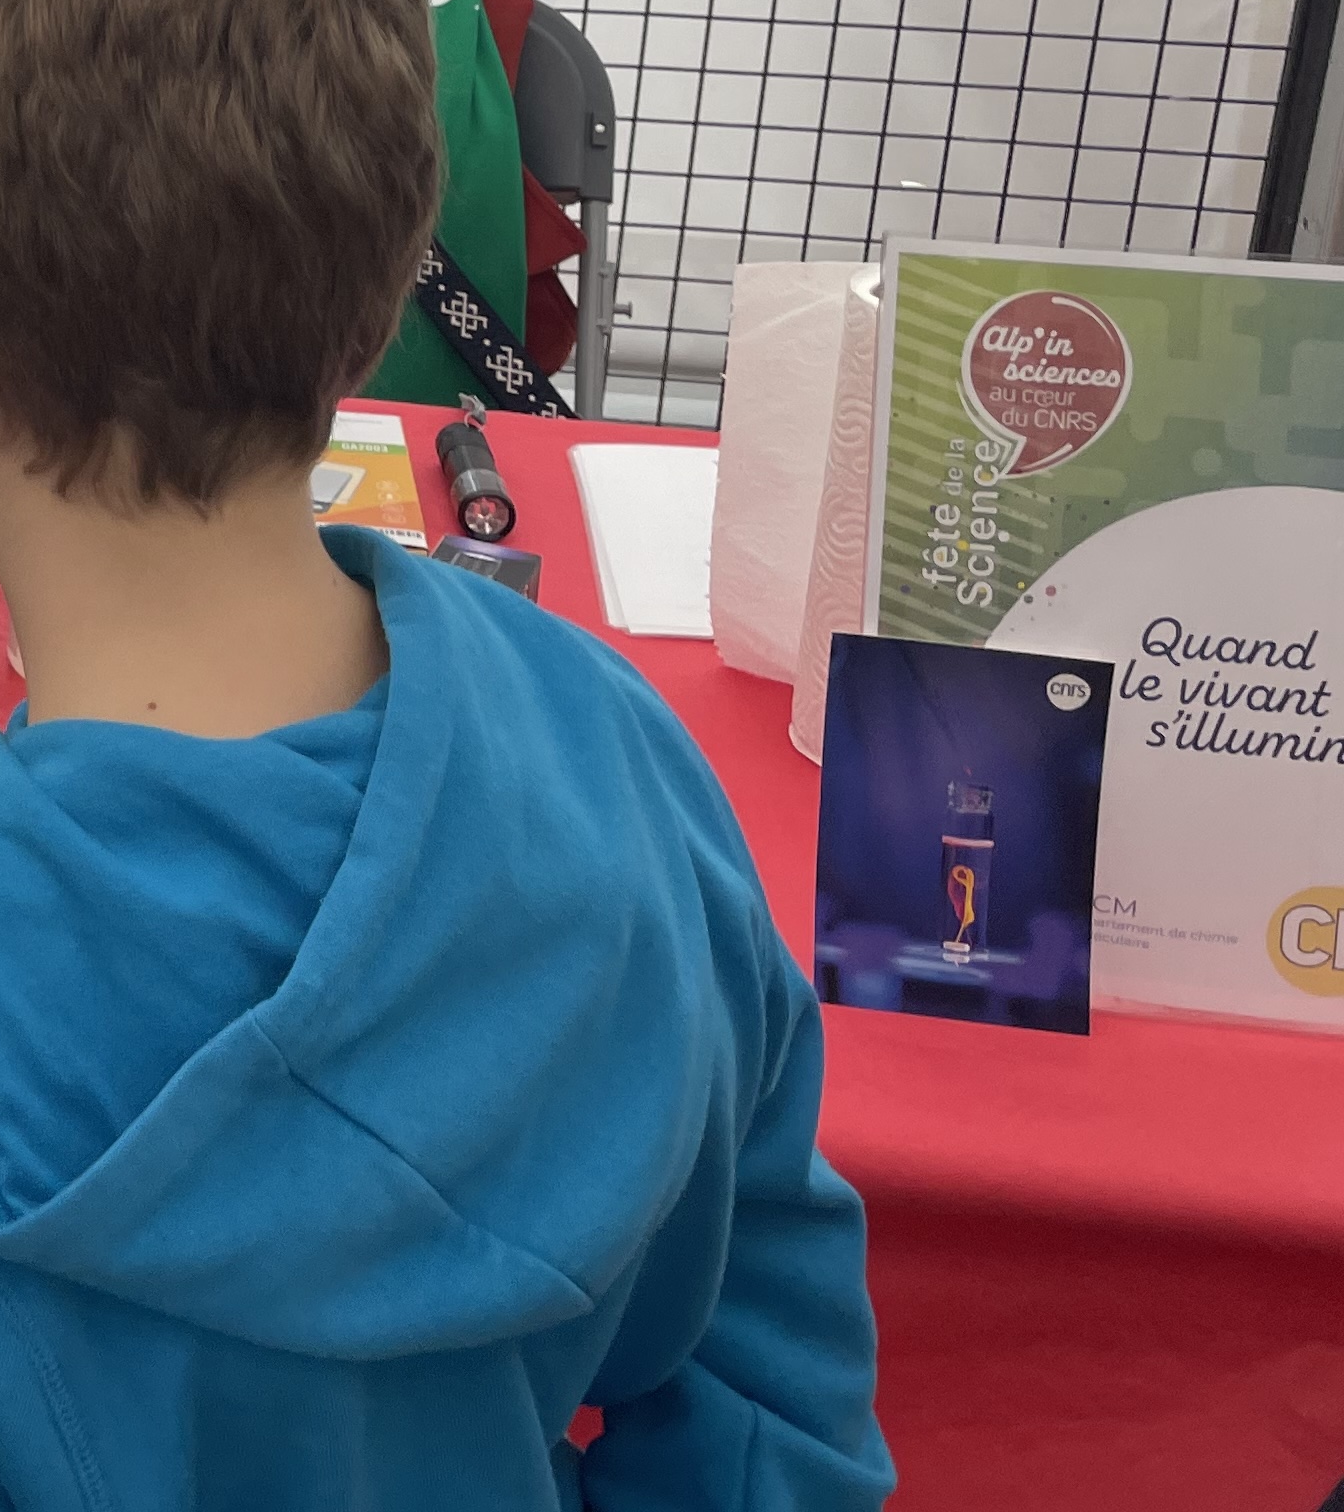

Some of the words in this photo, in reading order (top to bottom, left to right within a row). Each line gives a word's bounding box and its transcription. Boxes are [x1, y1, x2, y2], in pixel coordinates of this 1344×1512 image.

[1004, 357, 1121, 388] sciences
[989, 385, 1017, 403] au
[1002, 408, 1028, 428] du
[1033, 409, 1098, 432] CNRS
[945, 438, 966, 460] la
[944, 468, 964, 497] de
[957, 439, 1004, 609] Science
[922, 503, 961, 584] fête
[1141, 616, 1320, 671] Quand
[1049, 680, 1087, 700] cnrs
[1119, 658, 1164, 703] le
[1180, 670, 1333, 719] vivant
[1092, 893, 1139, 919] CM
